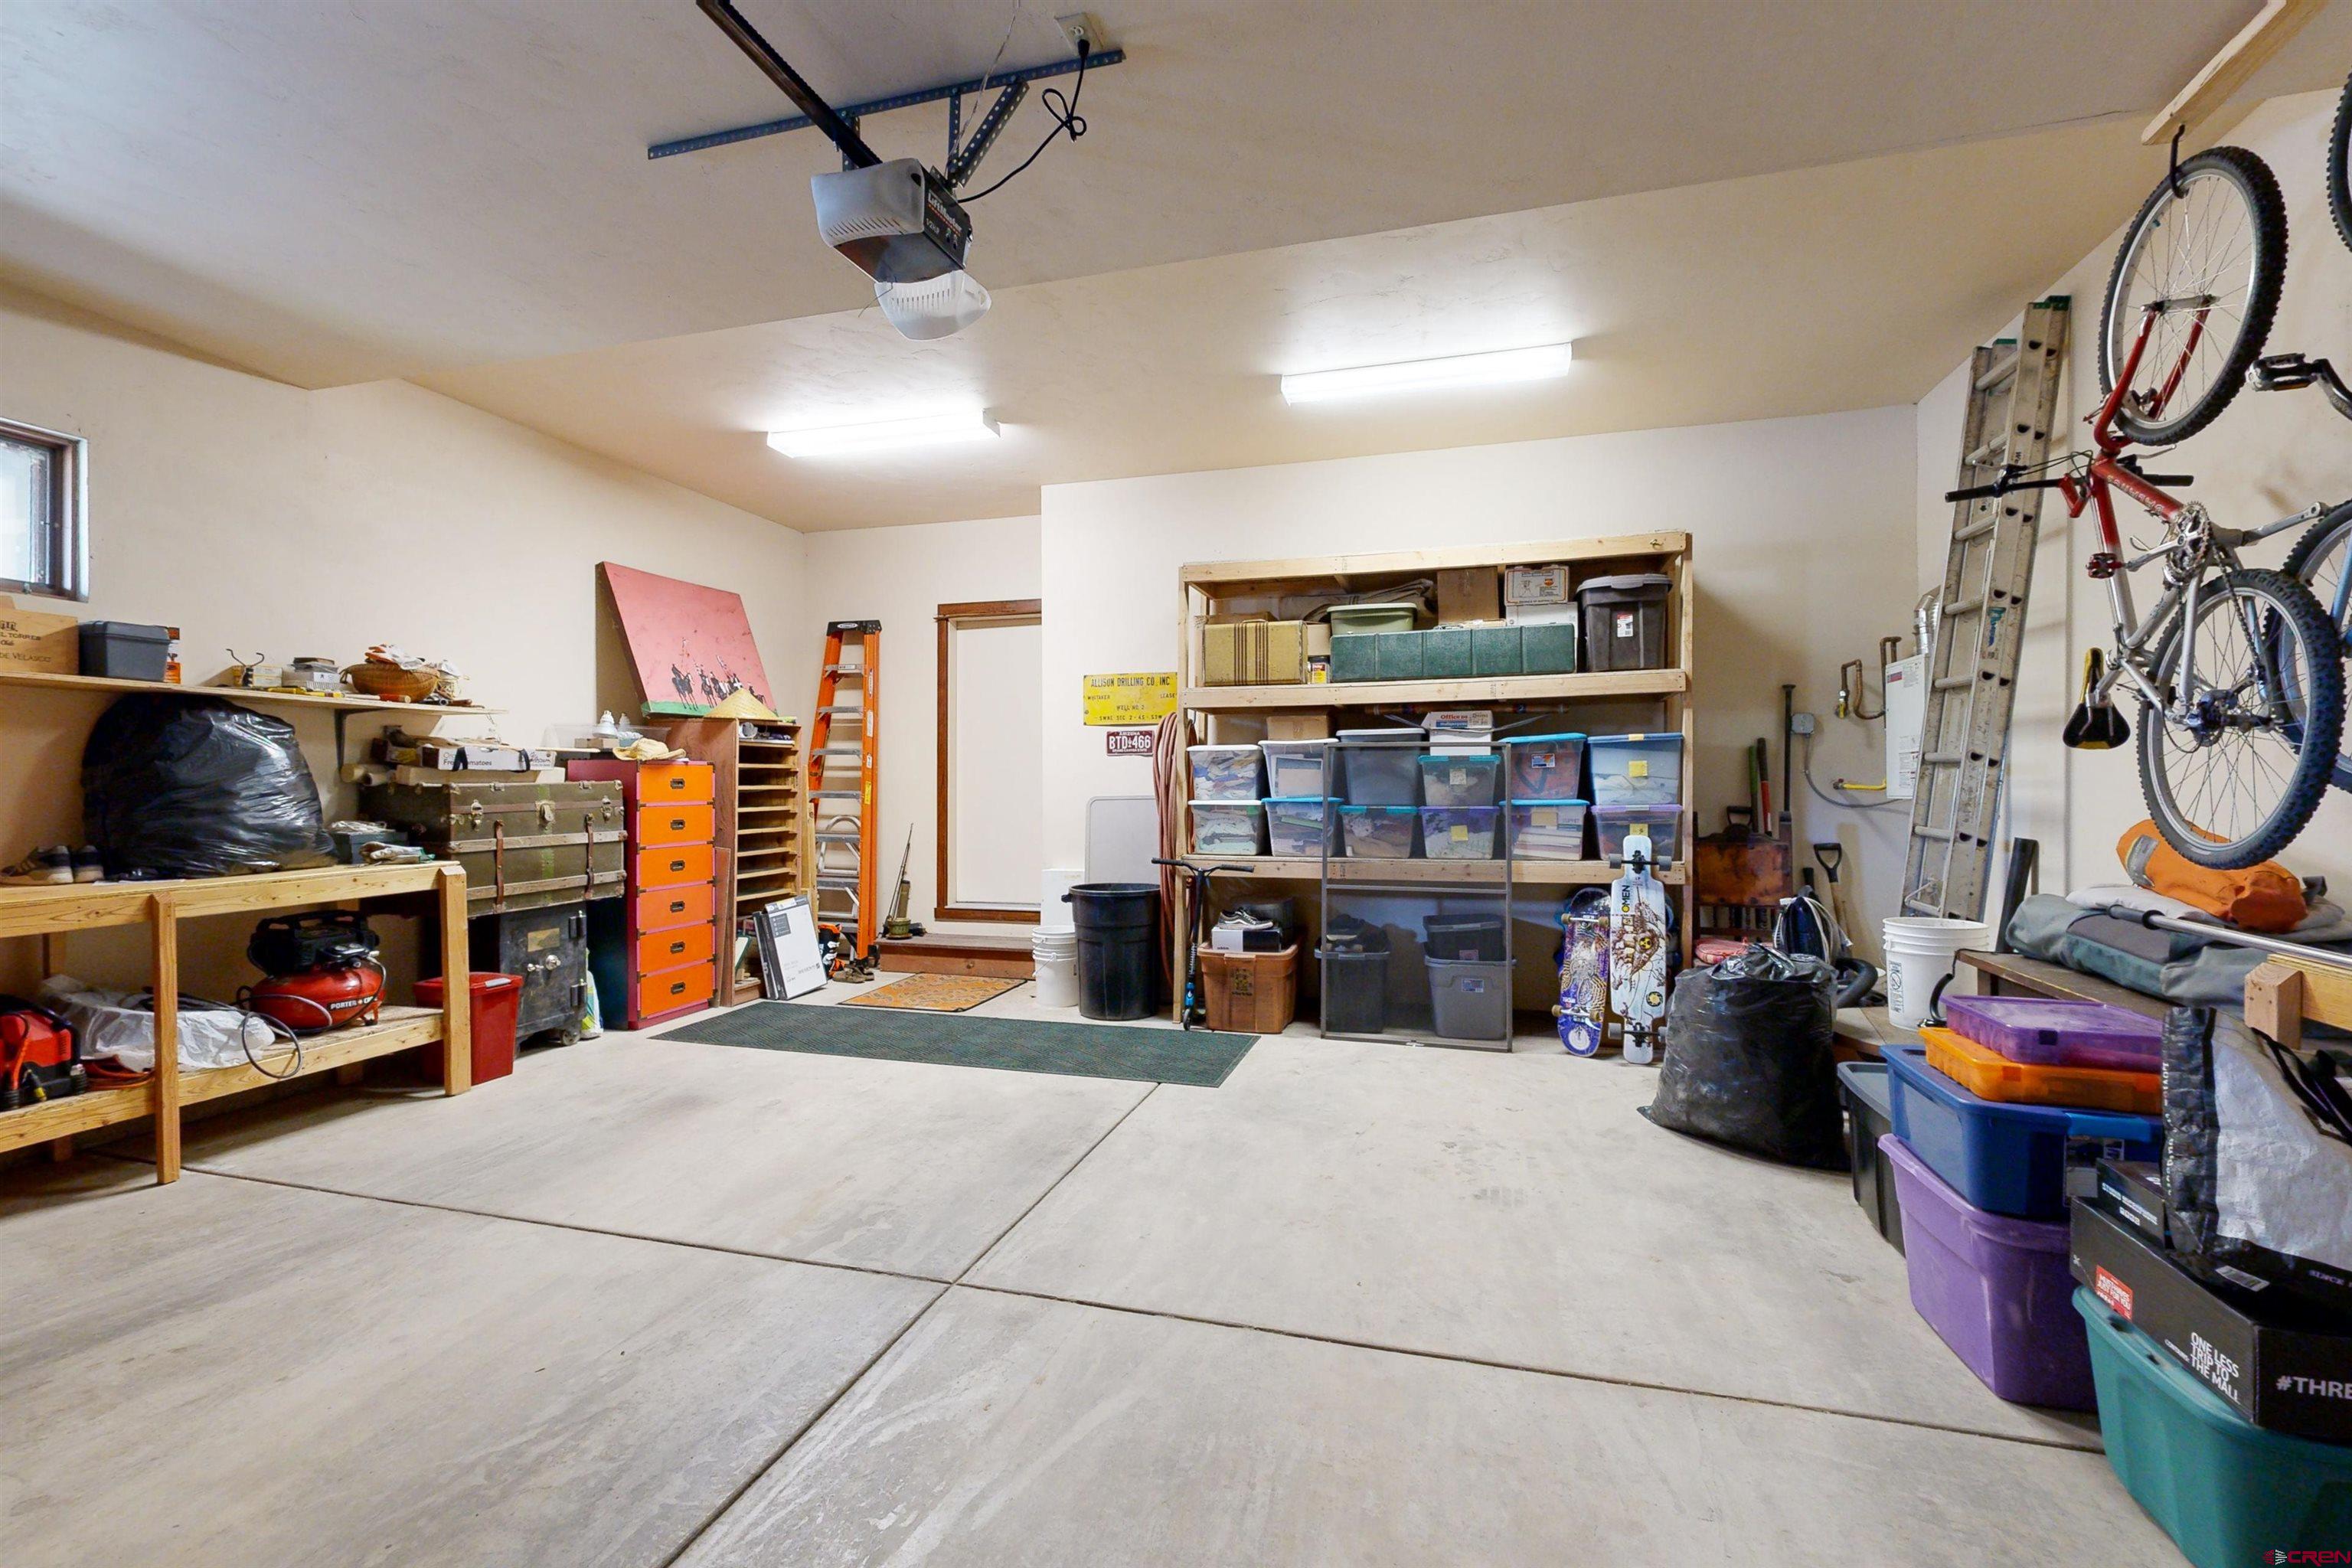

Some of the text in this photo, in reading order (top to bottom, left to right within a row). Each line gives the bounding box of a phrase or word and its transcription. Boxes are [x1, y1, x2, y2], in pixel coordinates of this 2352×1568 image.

[8, 632, 41, 641] TORRES
[12, 652, 52, 663] VELASCO
[1091, 678, 1115, 688] ALLISON
[1117, 677, 1144, 687] DRILLING
[1109, 734, 1151, 750] BTD 466
[330, 999, 358, 1010] PORTER
[2191, 1332, 2239, 1377] ONE LESS
[2190, 1342, 2230, 1382] TRIP TO
[2190, 1354, 2240, 1404] THE MALL
